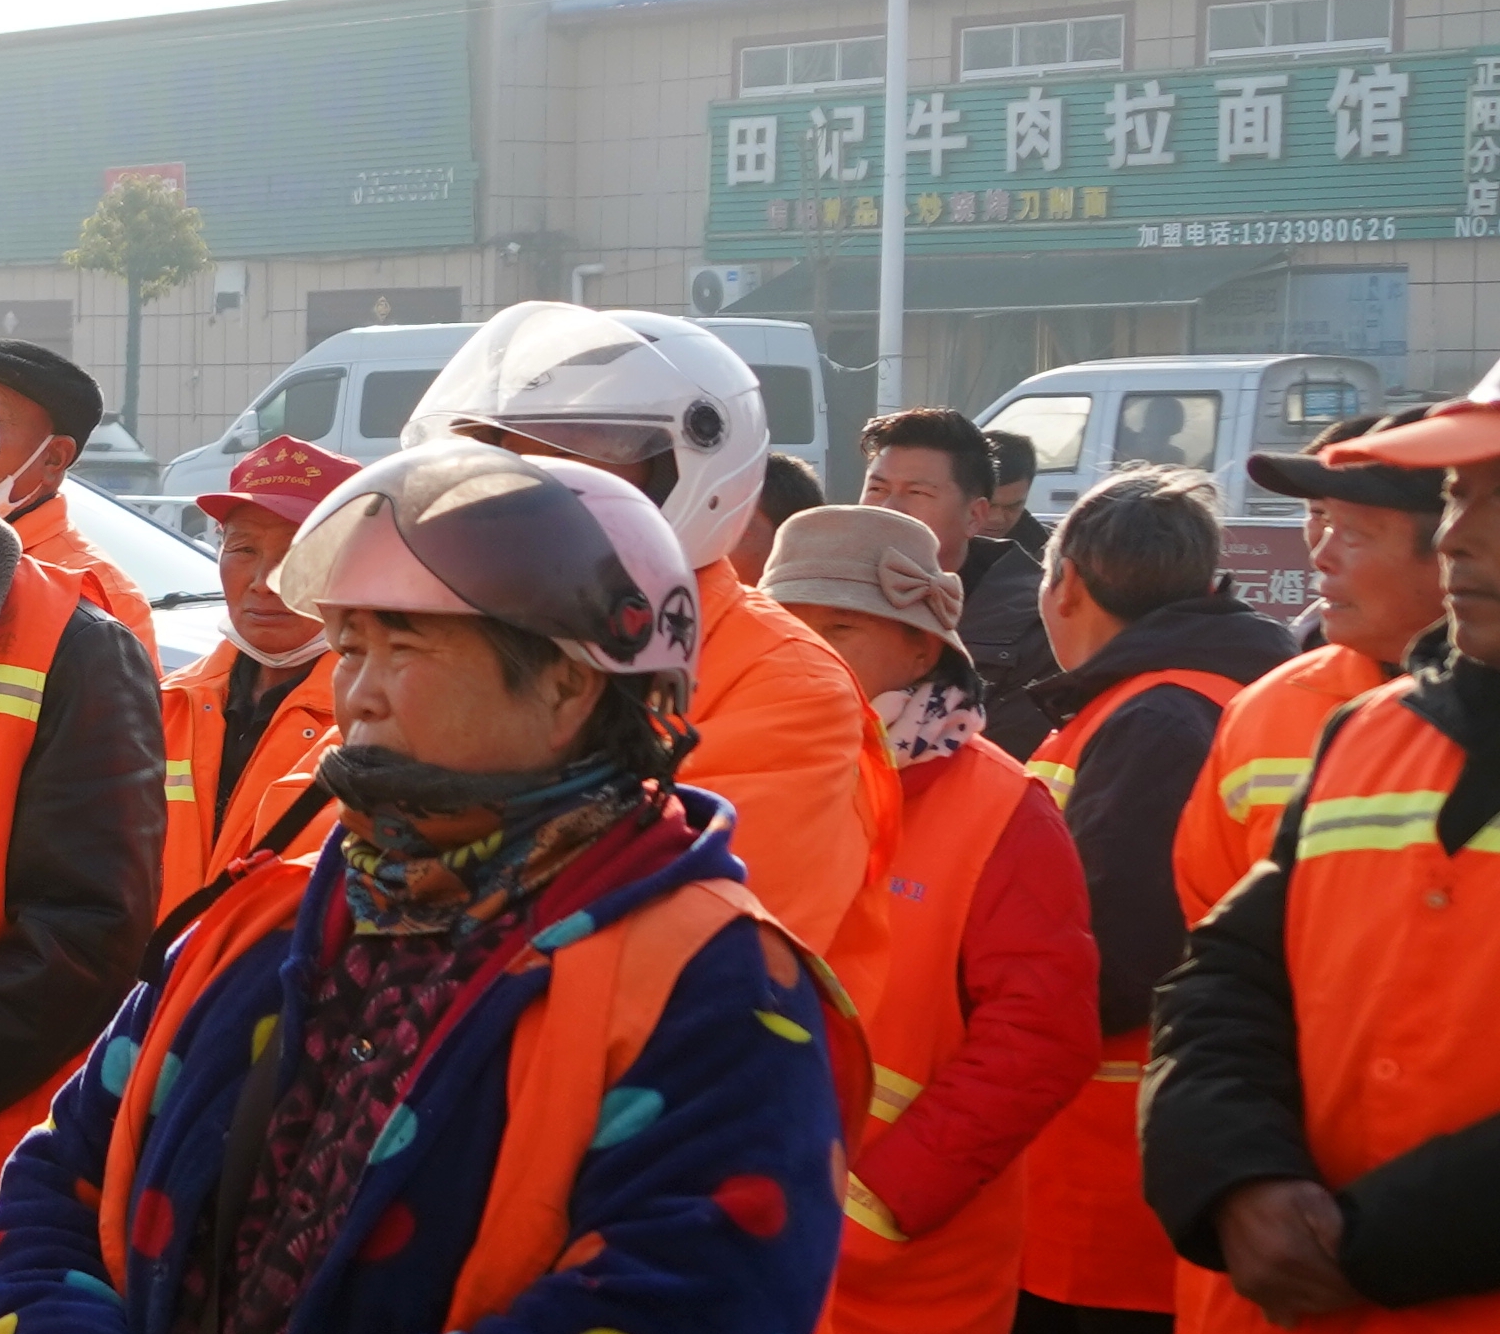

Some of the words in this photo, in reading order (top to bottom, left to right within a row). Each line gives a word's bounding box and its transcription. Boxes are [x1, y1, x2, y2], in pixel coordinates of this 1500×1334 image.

[727, 63, 1410, 186] 田记牛肉拉面馆
[767, 186, 1109, 231] 信阳精品炒烧烤刀削面
[1454, 217, 1500, 238] NO.
[1137, 217, 1396, 248] 加盟电话:13733980626
